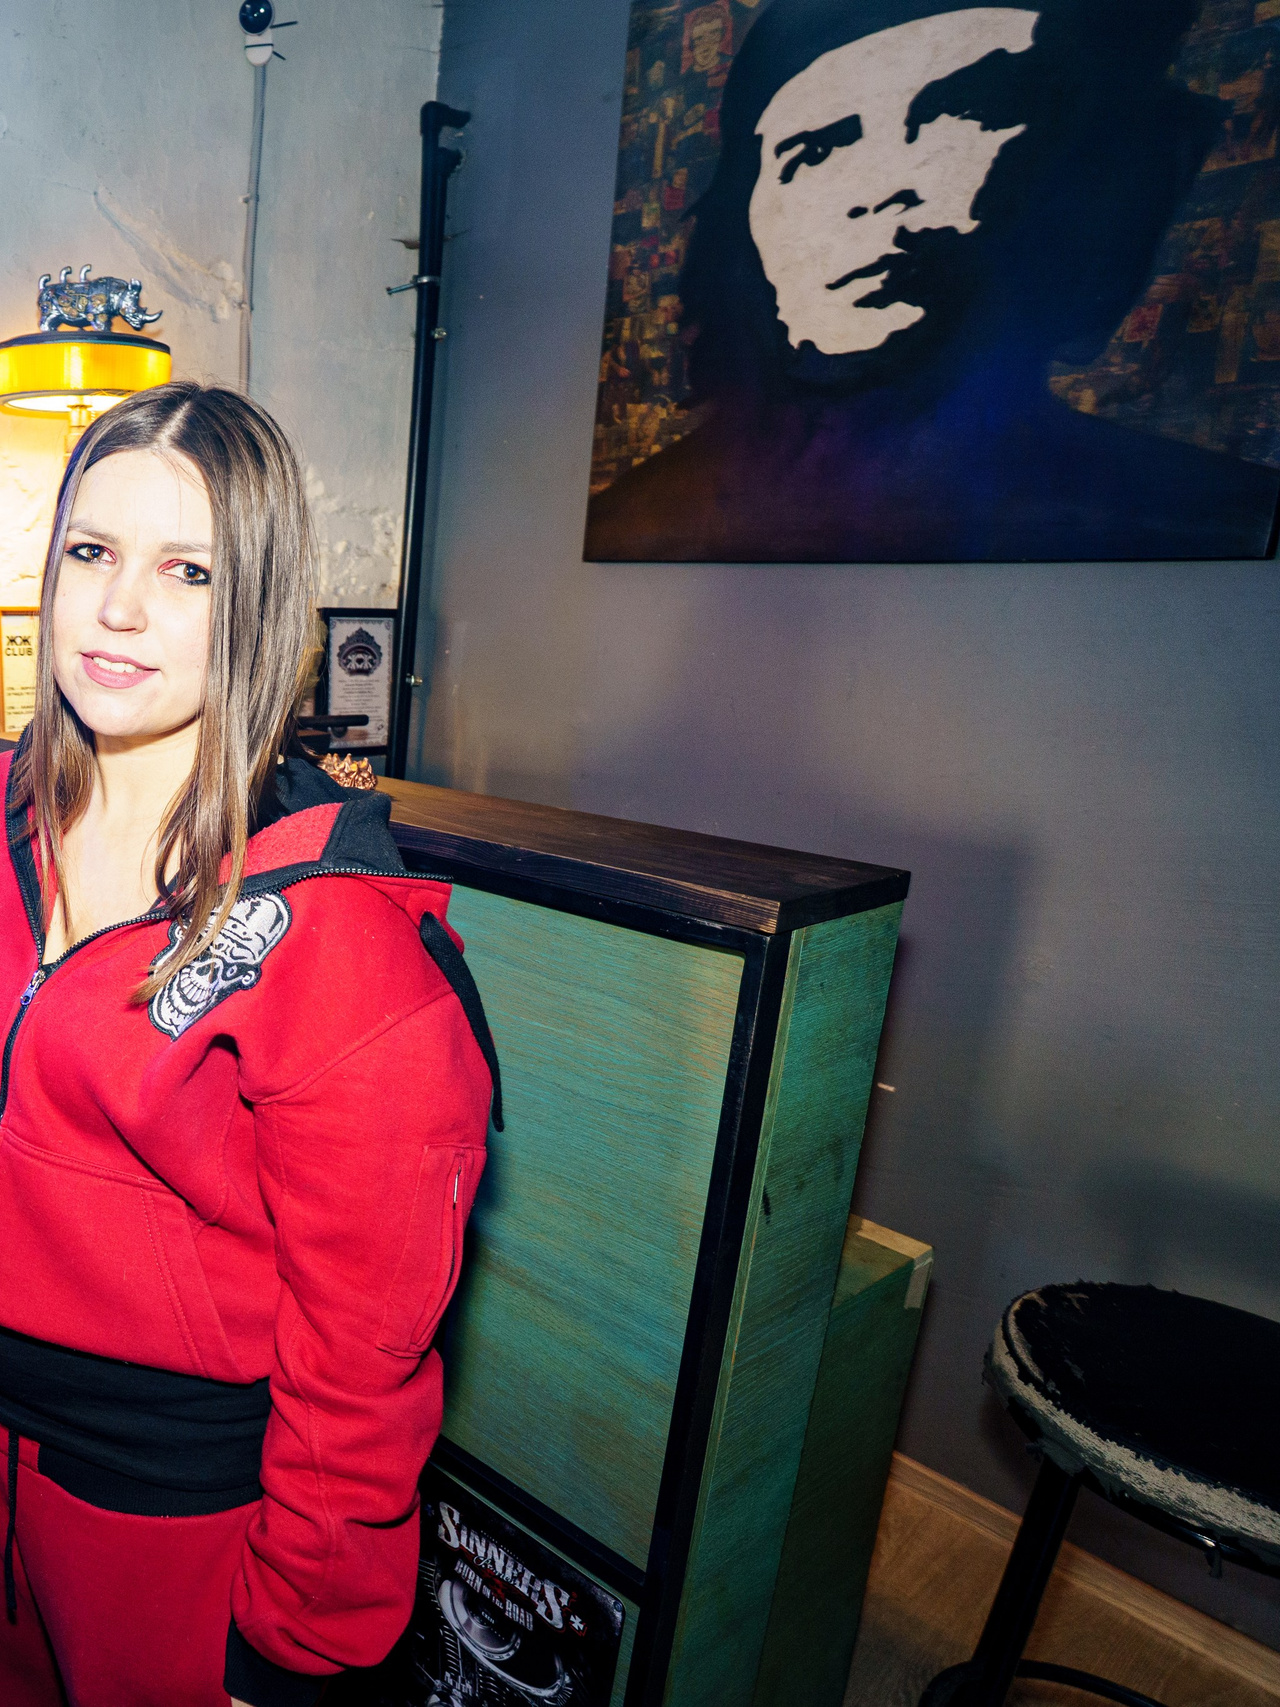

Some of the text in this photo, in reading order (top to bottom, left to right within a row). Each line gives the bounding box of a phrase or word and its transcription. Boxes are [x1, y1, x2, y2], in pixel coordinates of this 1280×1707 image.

[5, 647, 33, 657] CLUB
[437, 1501, 570, 1629] SINNERS
[454, 1558, 483, 1593] BURN
[482, 1584, 491, 1599] ON
[504, 1597, 534, 1631] ROAD
